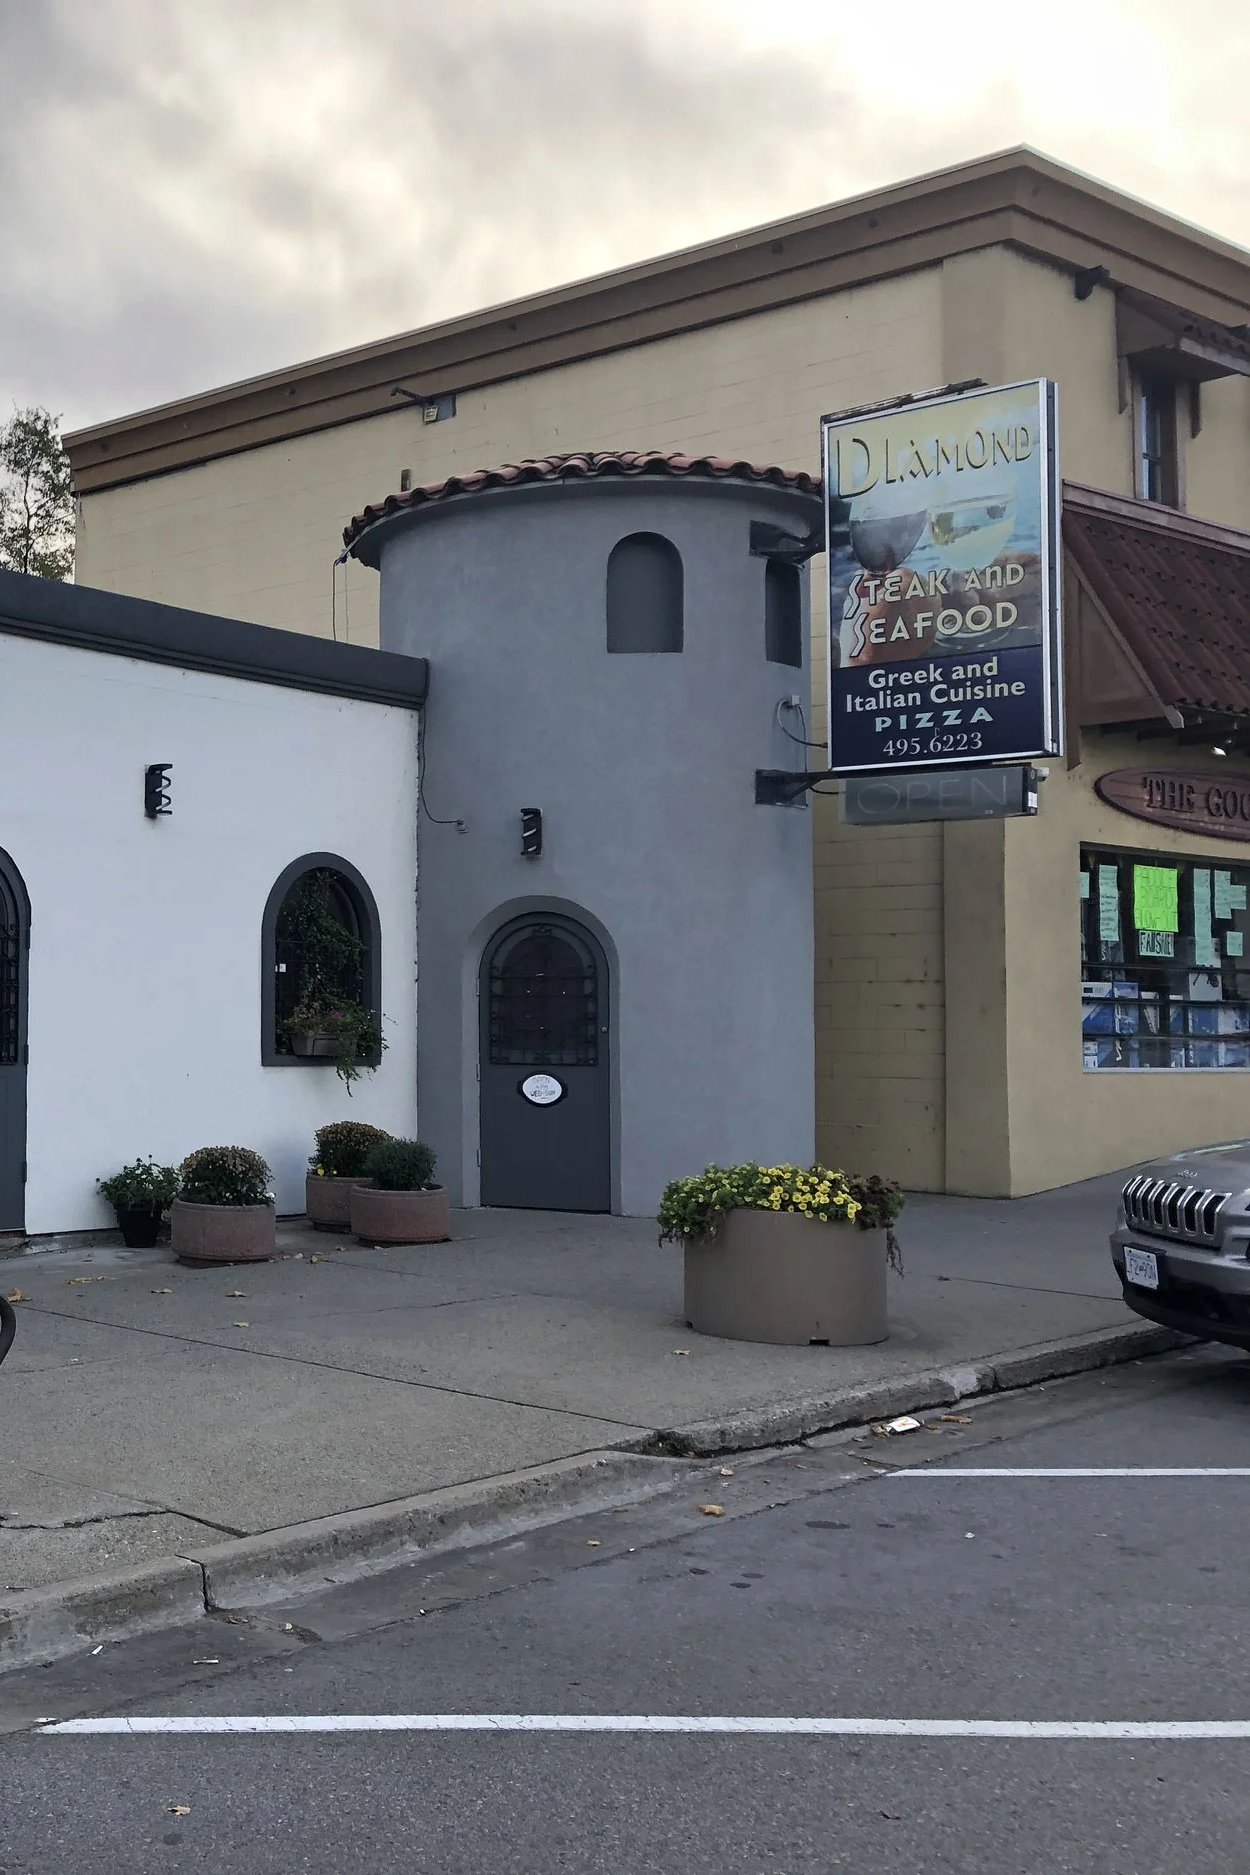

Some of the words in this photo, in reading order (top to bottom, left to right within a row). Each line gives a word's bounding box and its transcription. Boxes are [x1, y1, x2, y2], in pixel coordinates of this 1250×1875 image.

[836, 426, 1034, 500] DIAMOND
[844, 567, 950, 619] STEAK
[849, 601, 1019, 658] SEAFOOD
[868, 664, 943, 689] Greek
[951, 656, 998, 679] and
[846, 690, 921, 712] Italian
[929, 679, 1026, 704] Cuisine
[875, 707, 994, 732] PIZZA
[883, 732, 983, 757] 495.6223
[857, 775, 1007, 814] OPEN
[1142, 776, 1195, 814] THE
